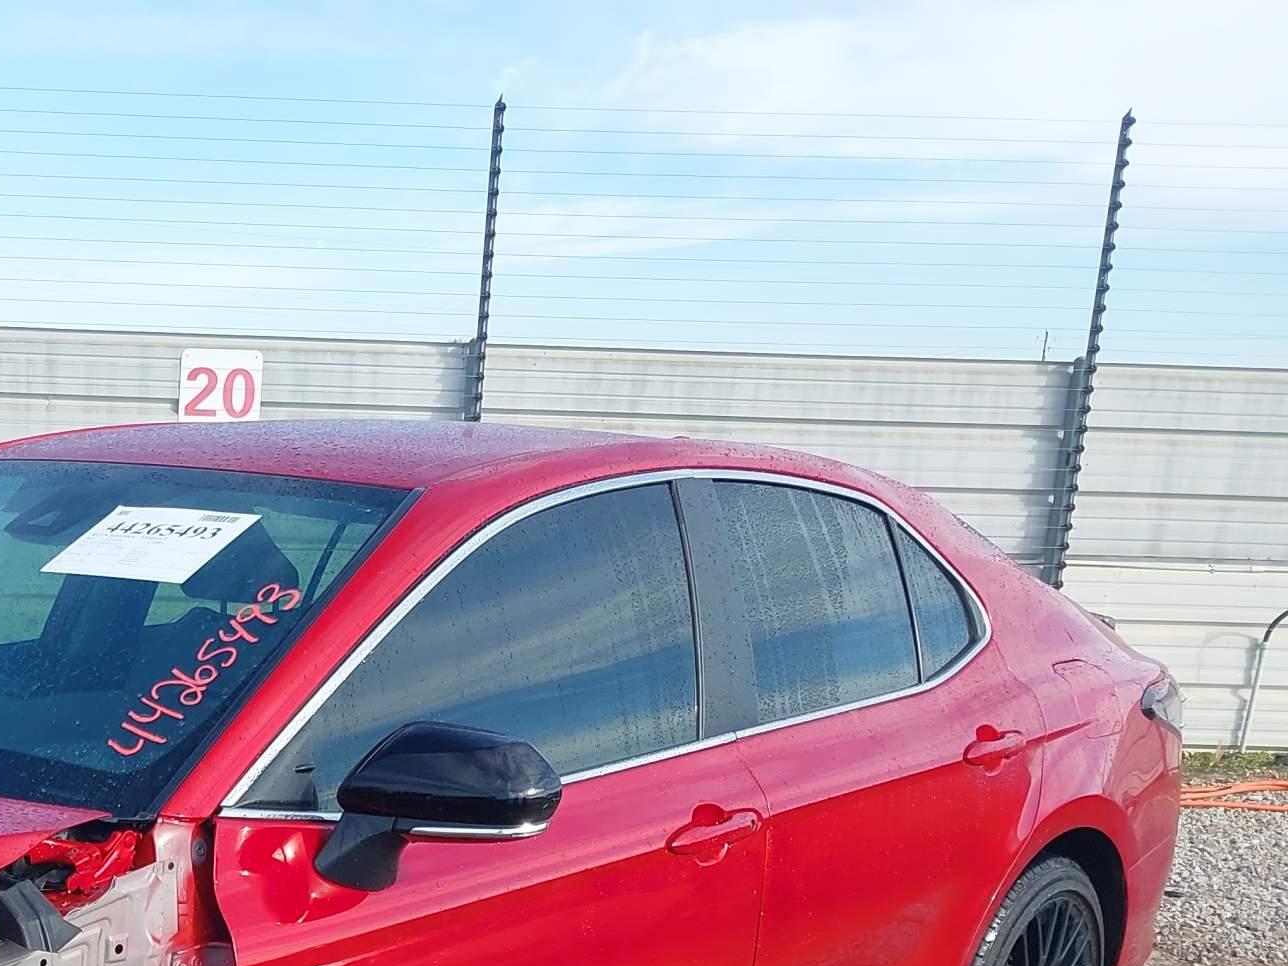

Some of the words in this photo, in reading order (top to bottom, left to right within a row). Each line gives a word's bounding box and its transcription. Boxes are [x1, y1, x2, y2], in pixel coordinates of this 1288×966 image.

[184, 367, 255, 418] 20
[106, 521, 223, 540] 44265493
[108, 583, 303, 757] 44265493
